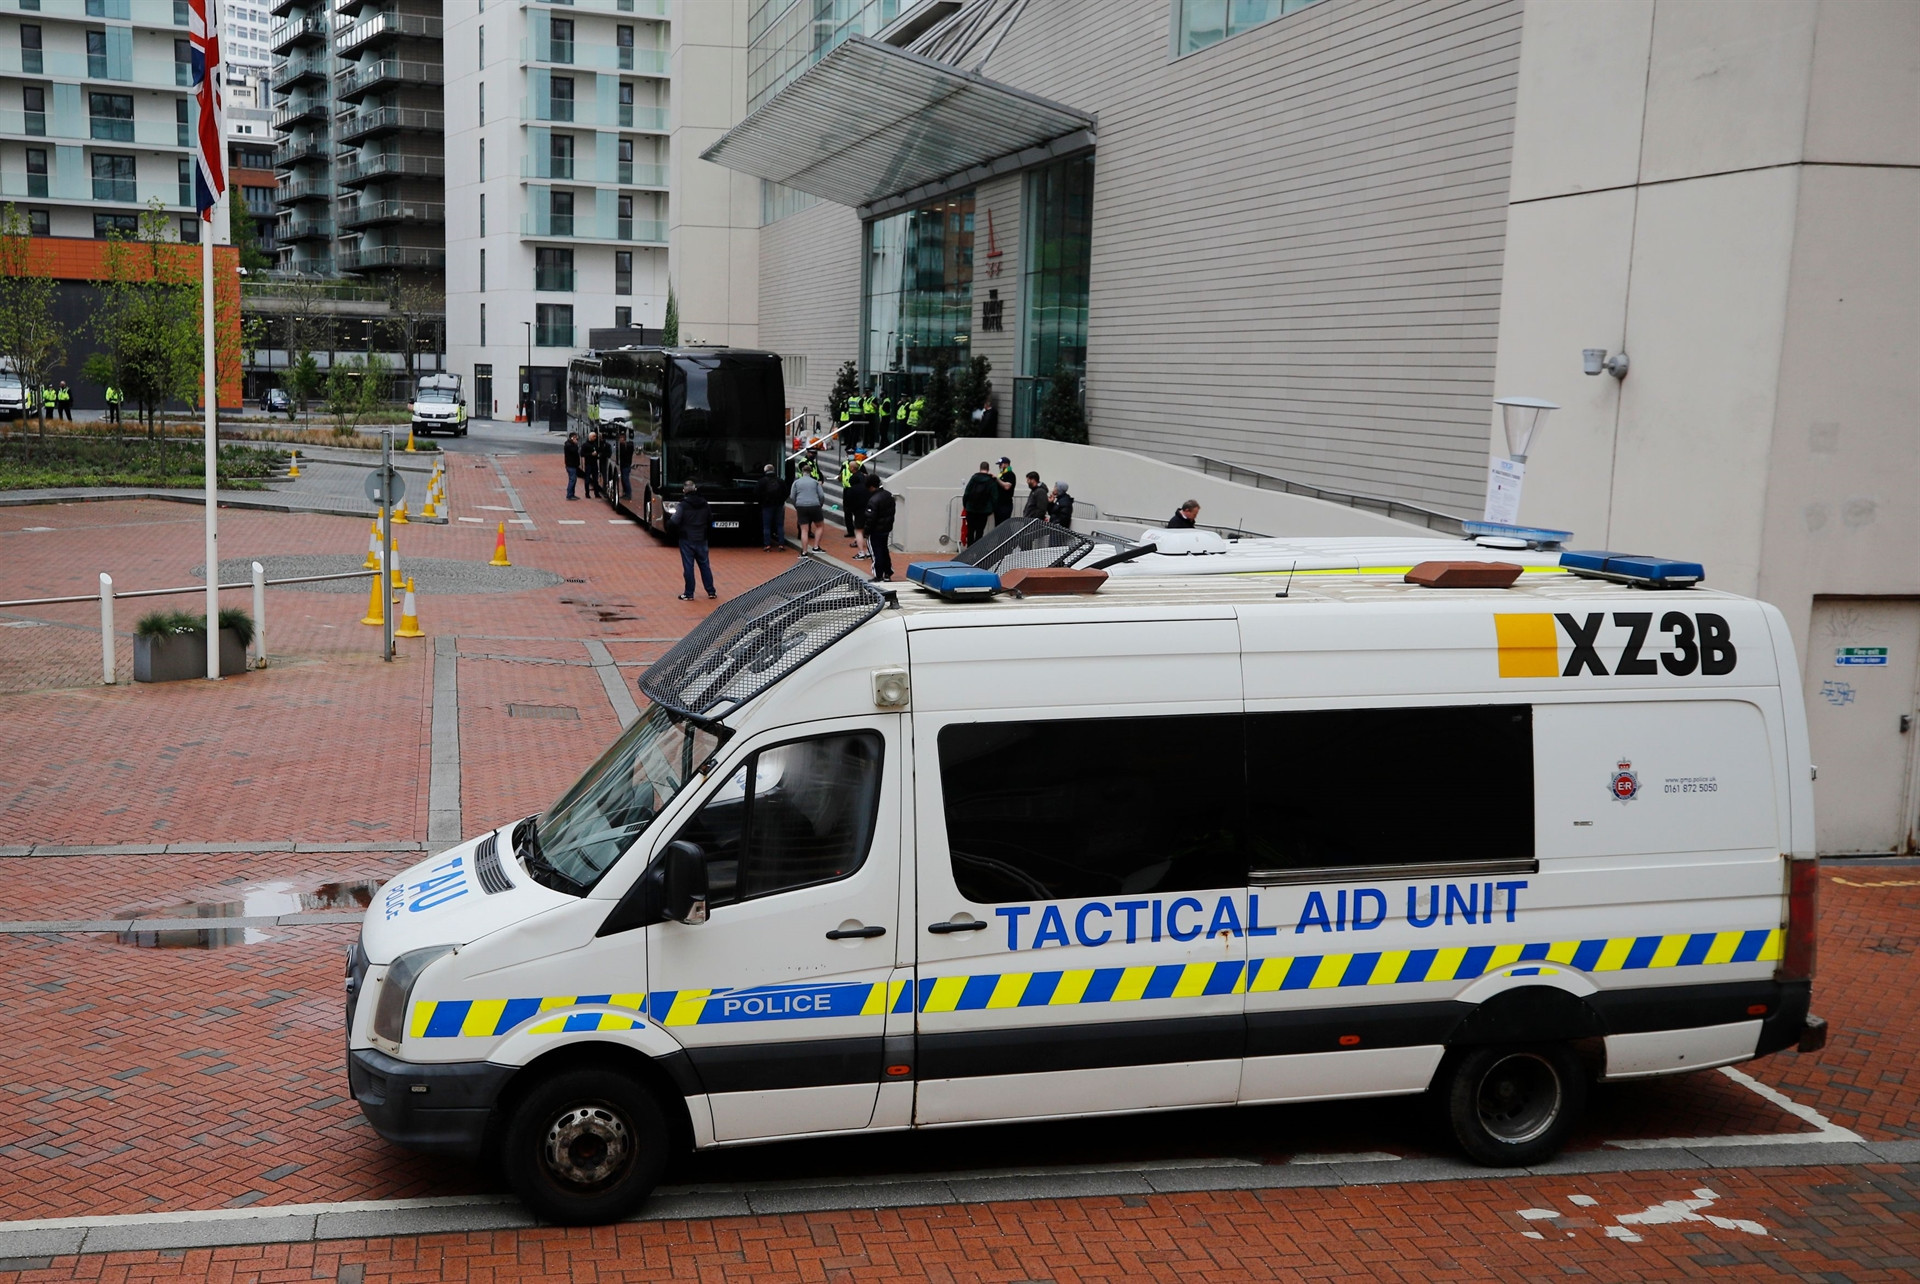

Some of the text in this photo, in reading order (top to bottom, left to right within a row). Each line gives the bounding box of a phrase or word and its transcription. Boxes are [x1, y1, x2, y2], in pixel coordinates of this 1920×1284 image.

[1553, 611, 1737, 677] XZ3B
[1664, 783, 1718, 793] 0161 872 5050
[385, 884, 404, 920] POLICE
[408, 857, 469, 912] TAU
[995, 880, 1528, 950] TACTICAL AID UNIT
[724, 994, 831, 1016] POLICE
